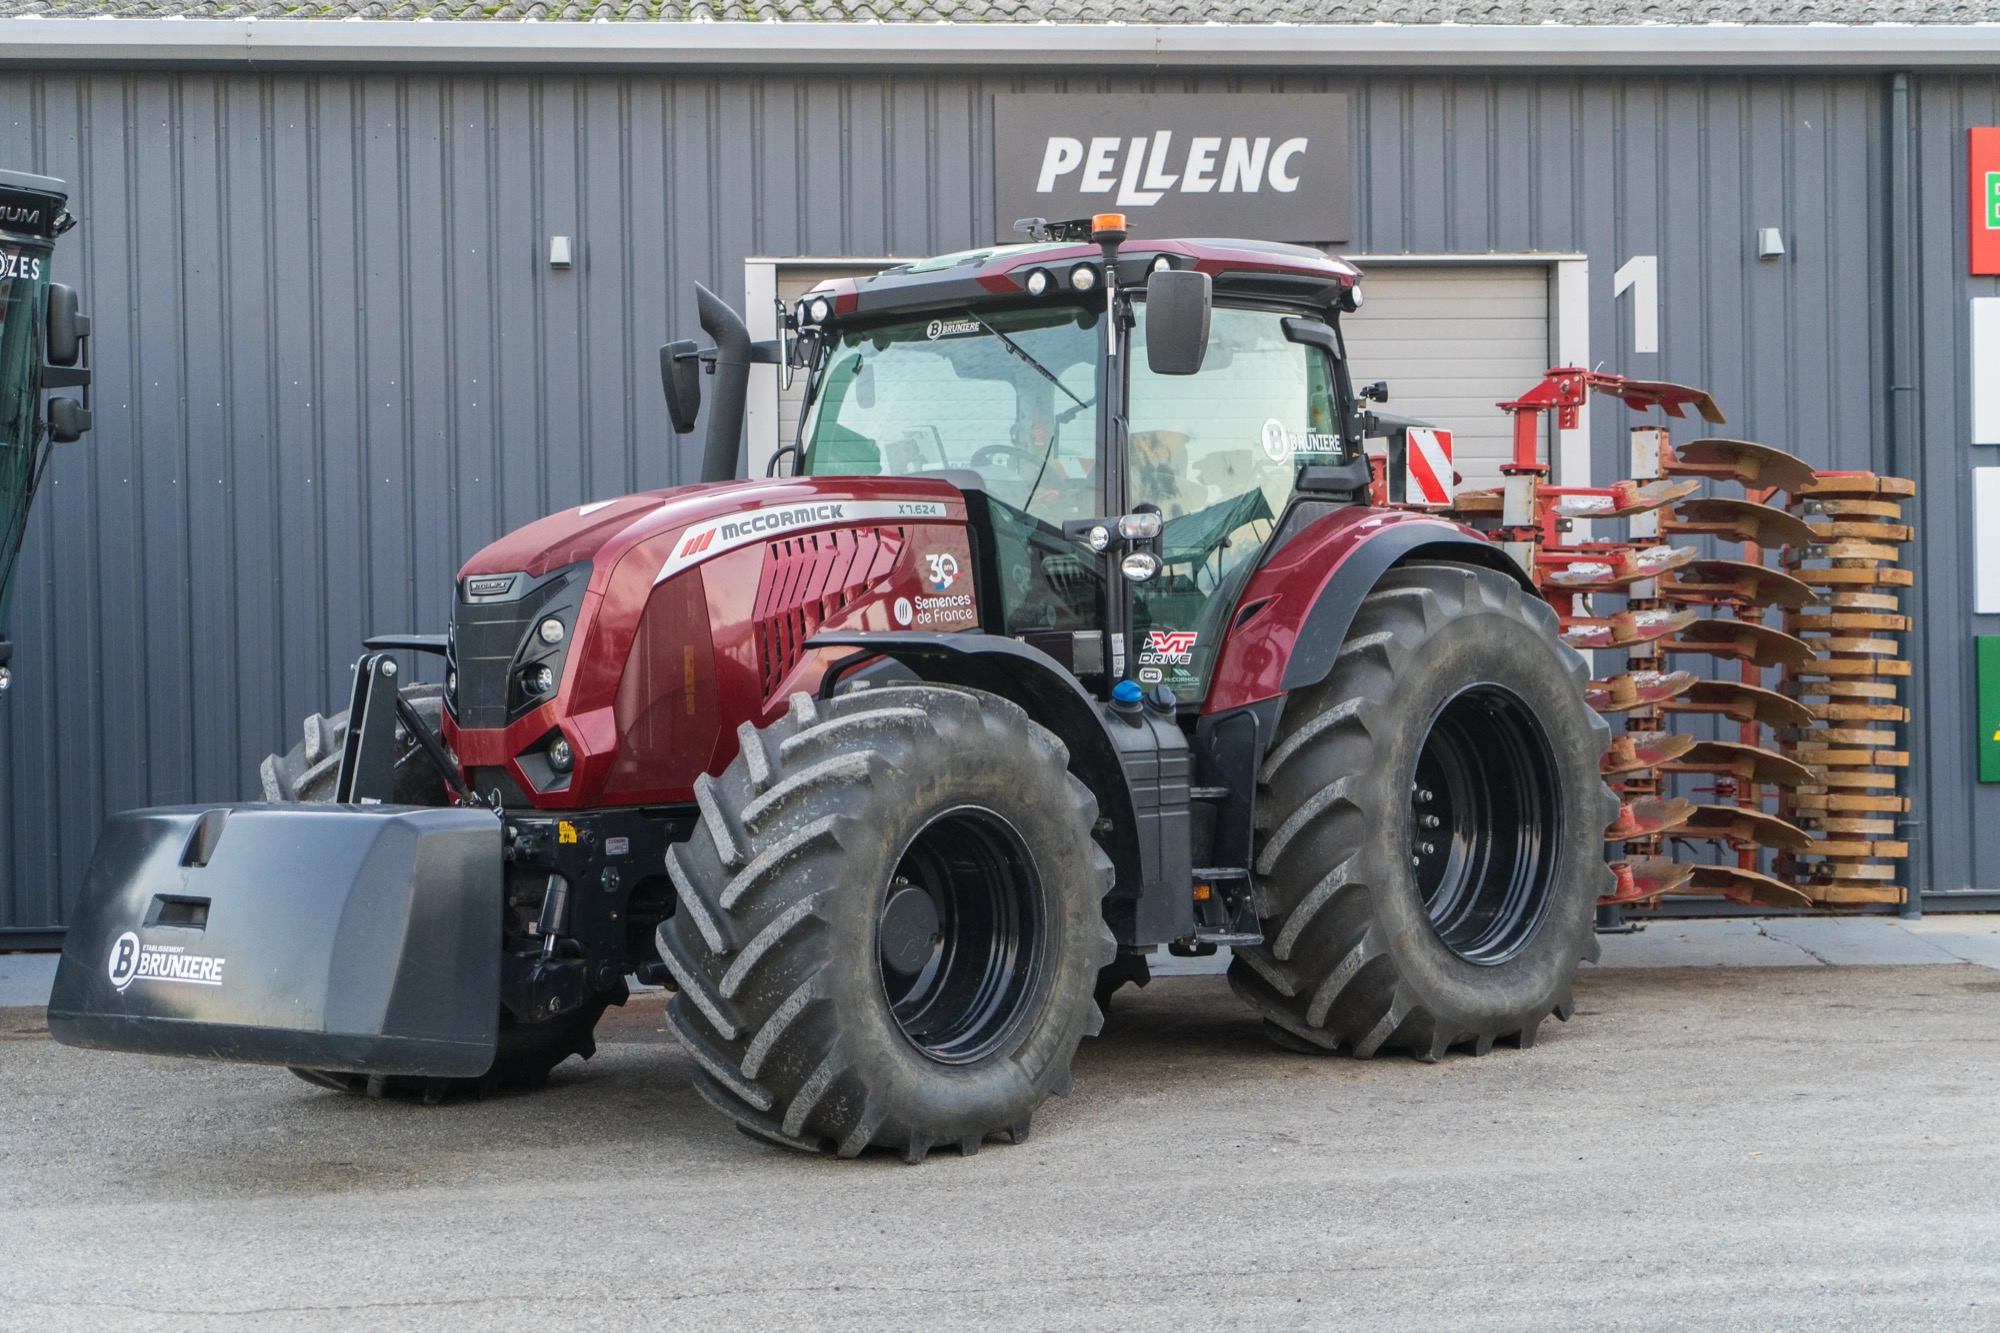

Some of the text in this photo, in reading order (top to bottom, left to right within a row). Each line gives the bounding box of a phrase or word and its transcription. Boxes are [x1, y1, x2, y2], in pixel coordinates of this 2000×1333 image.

[1036, 130, 1308, 206] PELLENC
[1614, 256, 1658, 353] 1
[942, 321, 980, 334] BRUNIERE
[1289, 434, 1341, 452] BRUNIERE
[898, 504, 936, 515] X7.624
[926, 553, 958, 587] 30
[914, 594, 971, 610] Semences
[917, 608, 973, 624] de France
[1140, 653, 1191, 664] DRIVE
[142, 944, 185, 953] ETABLISSEMENT
[138, 952, 226, 981] BRUNIERE
